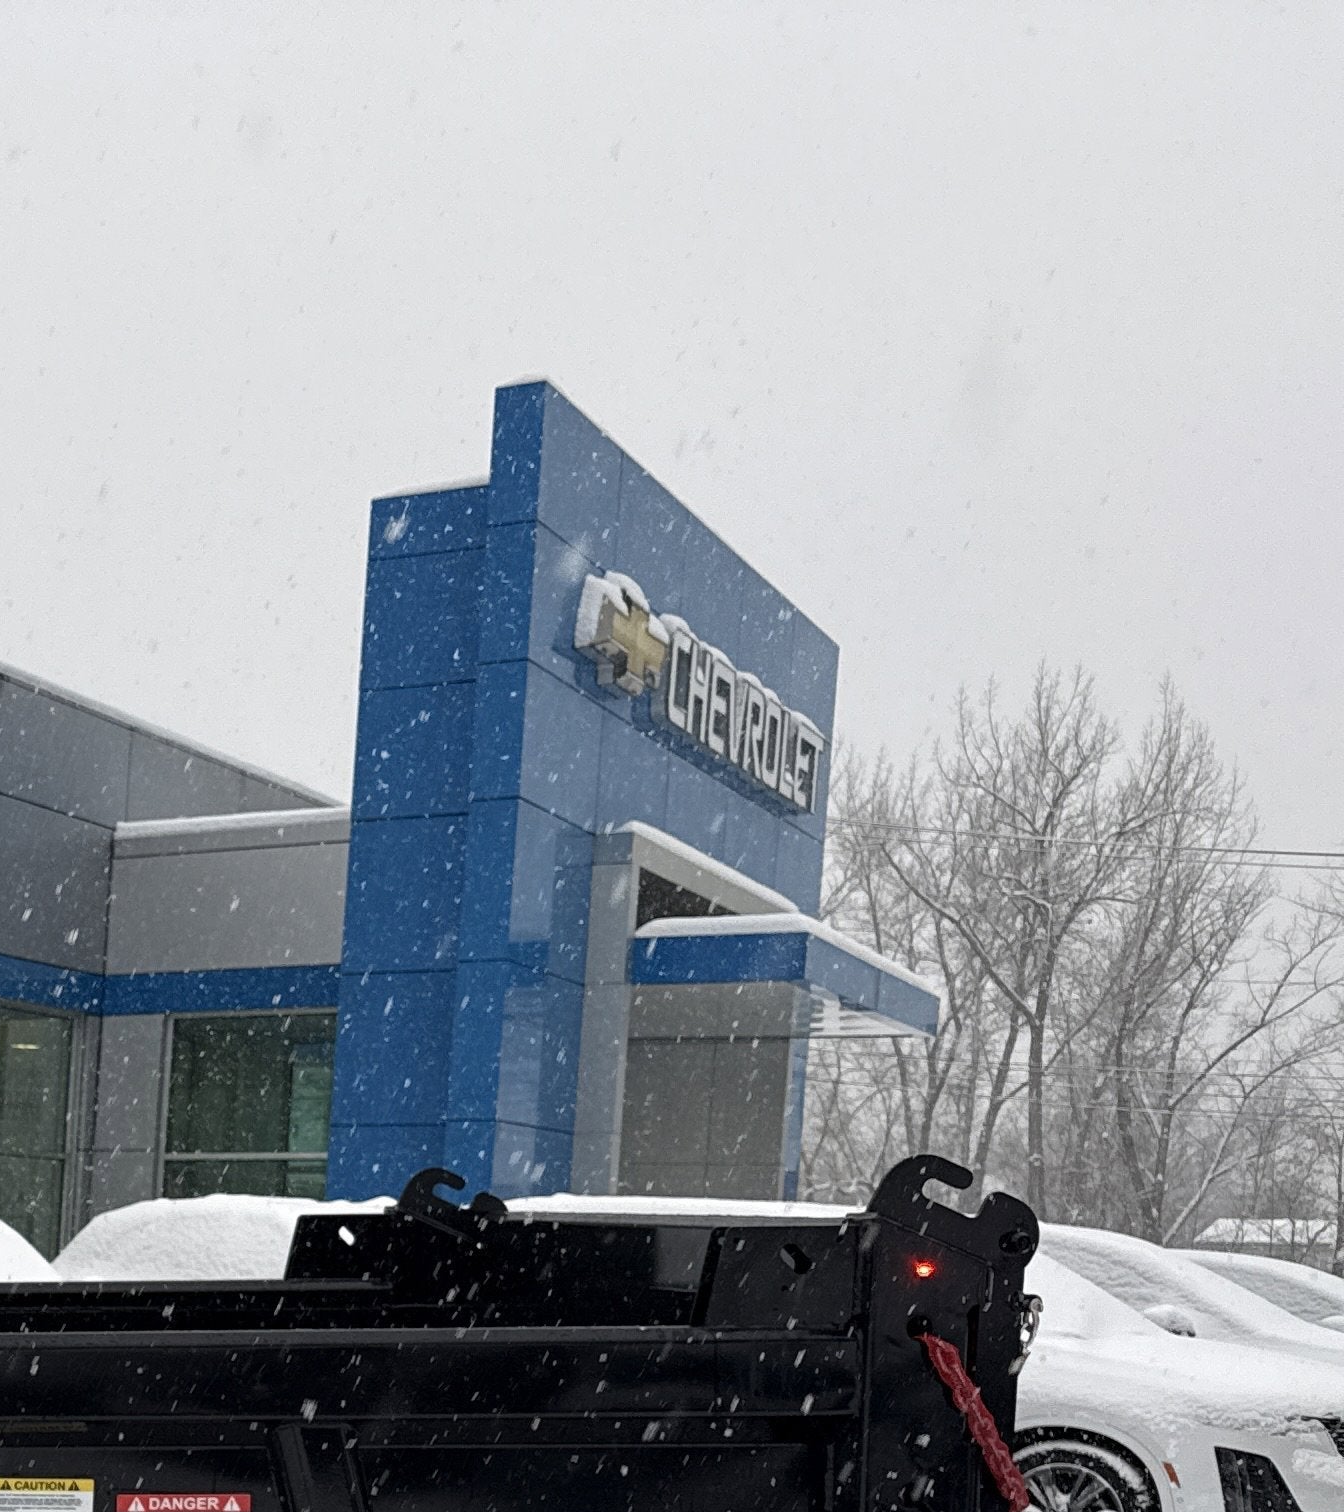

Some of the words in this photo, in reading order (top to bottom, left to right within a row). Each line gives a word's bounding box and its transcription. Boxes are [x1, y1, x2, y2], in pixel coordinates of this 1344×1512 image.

[666, 626, 824, 815] CHEVROLET
[13, 1480, 66, 1491] CAUTION
[148, 1497, 220, 1511] DANGER
